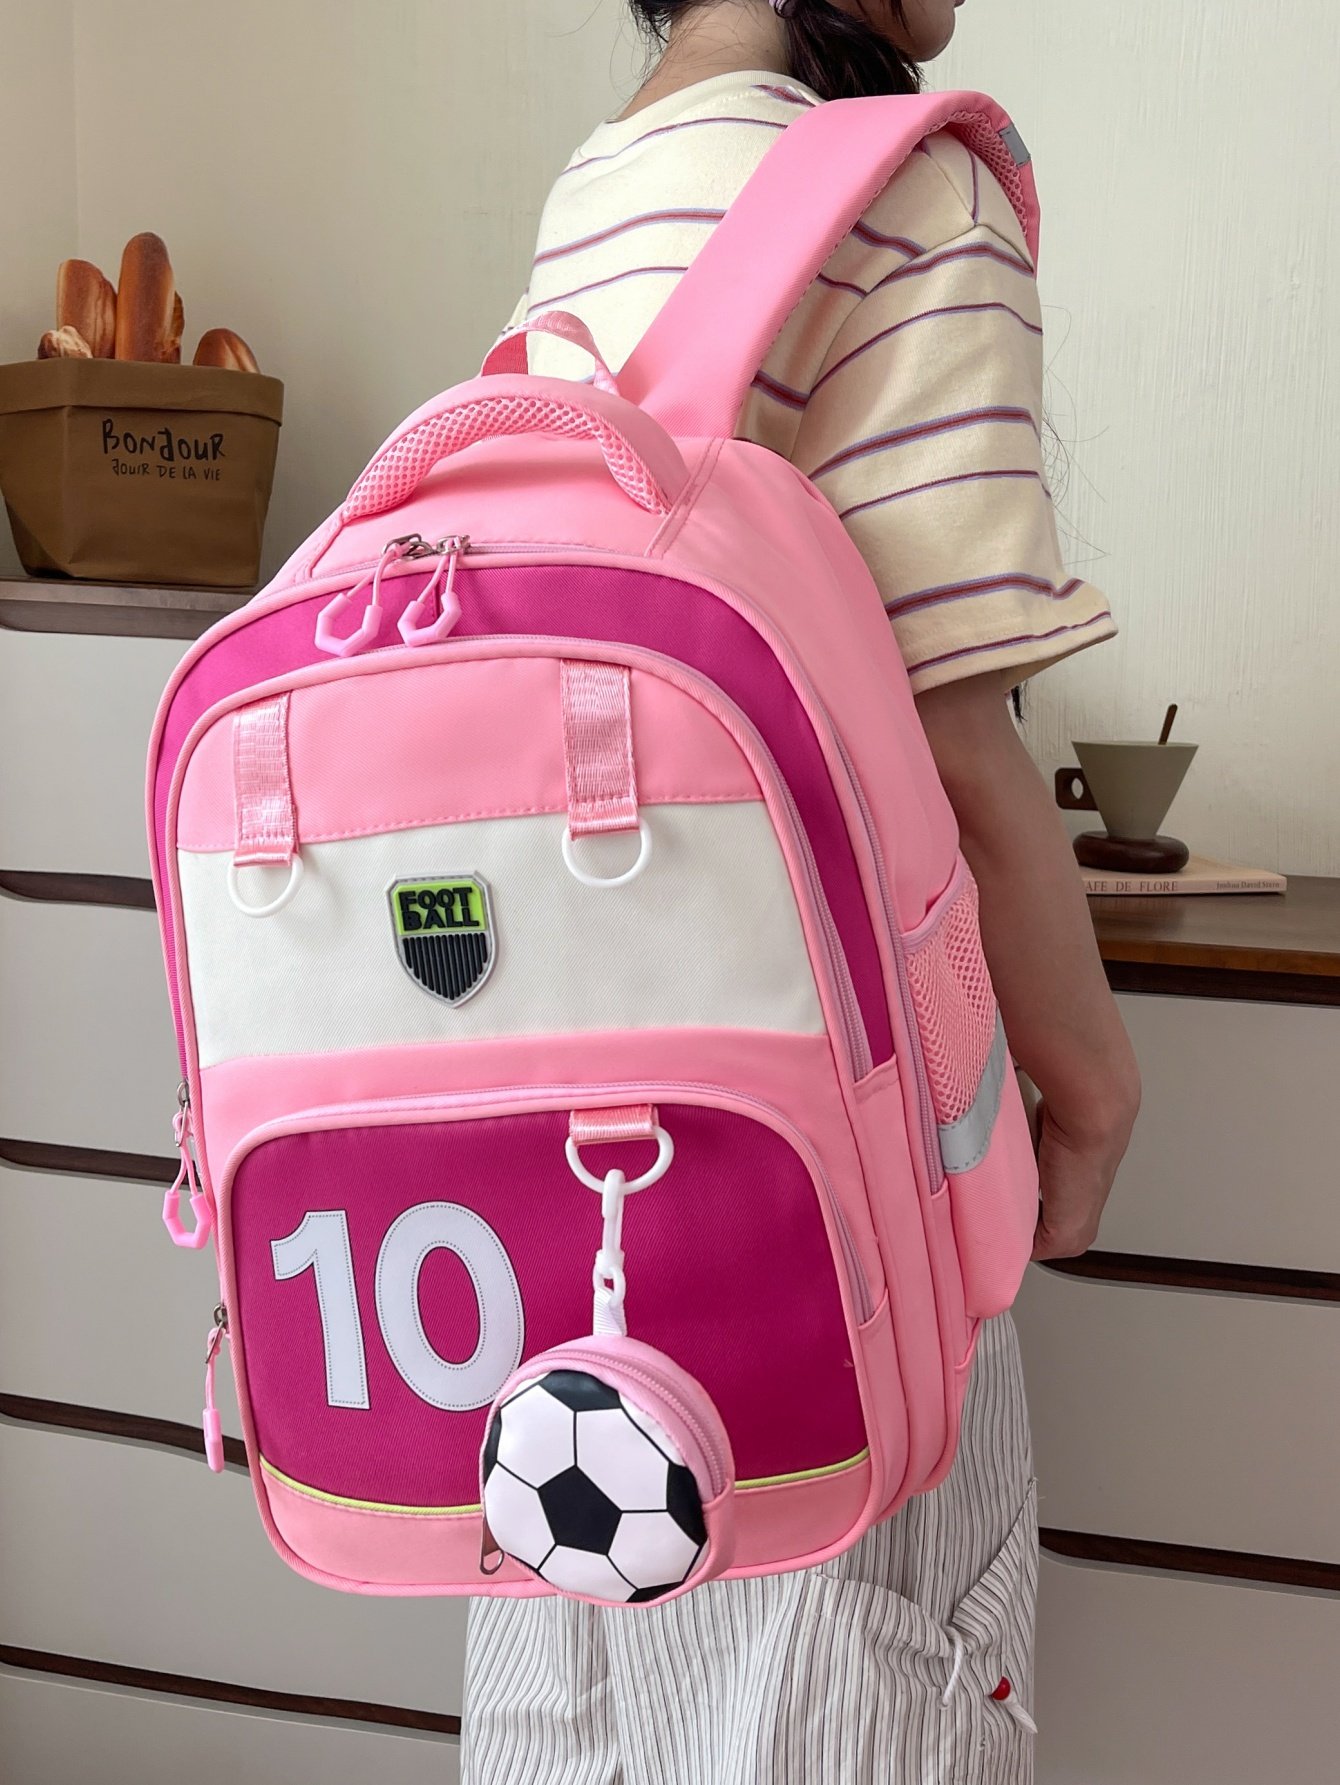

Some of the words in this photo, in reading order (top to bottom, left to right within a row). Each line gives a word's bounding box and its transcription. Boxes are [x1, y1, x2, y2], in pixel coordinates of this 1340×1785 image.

[157, 465, 176, 479] DE
[183, 466, 197, 480] LA
[204, 467, 221, 481] VIE
[1086, 880, 1107, 892] AFE
[1115, 880, 1132, 892] DE
[1139, 880, 1178, 892] FLORE
[1241, 879, 1261, 889] David
[398, 886, 473, 913] FOOT
[402, 906, 480, 931] BALL
[269, 1200, 526, 1412] 10
